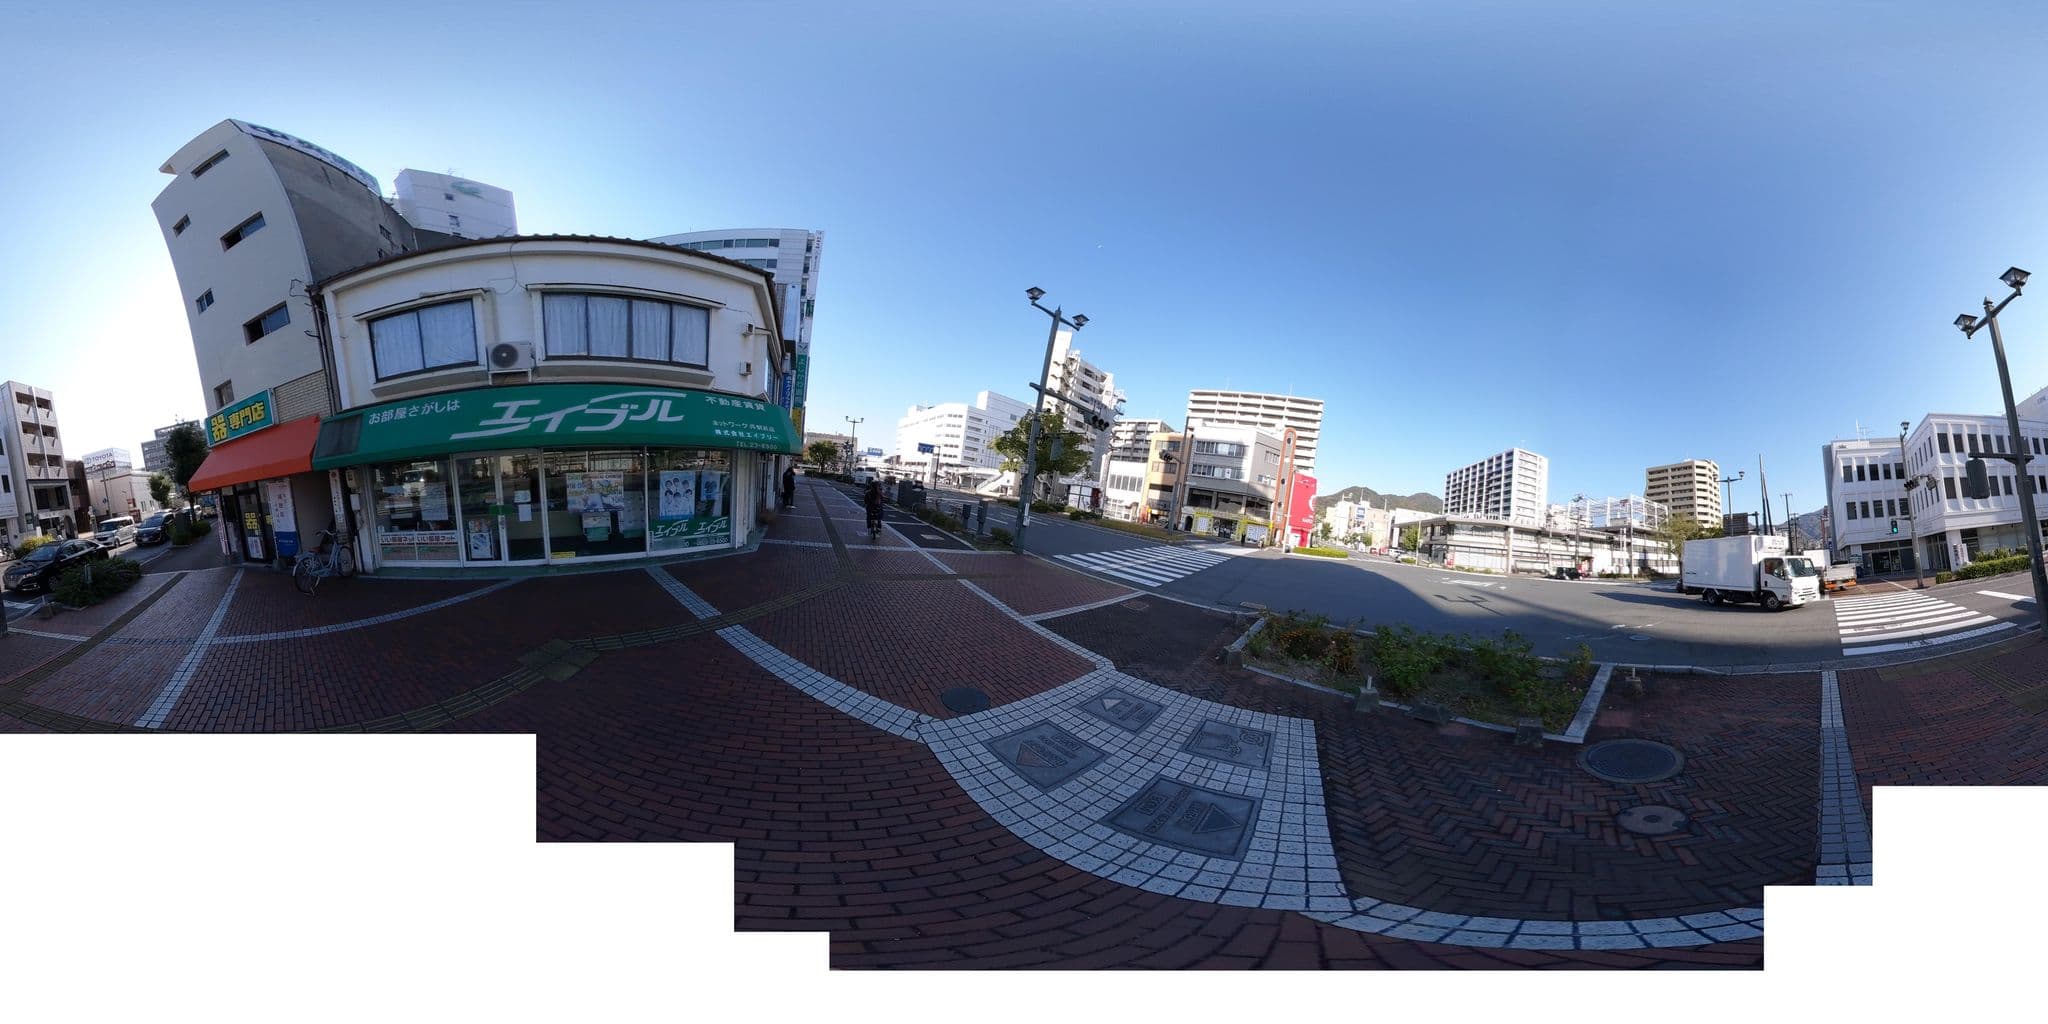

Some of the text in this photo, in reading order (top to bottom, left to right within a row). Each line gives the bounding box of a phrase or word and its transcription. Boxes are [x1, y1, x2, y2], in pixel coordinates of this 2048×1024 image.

[368, 399, 461, 425] お部屋さがしは
[450, 391, 686, 440] エイブル
[705, 395, 767, 412] 不動産賃貸
[210, 401, 265, 442] 器専門店
[92, 453, 113, 462] TOYOTA
